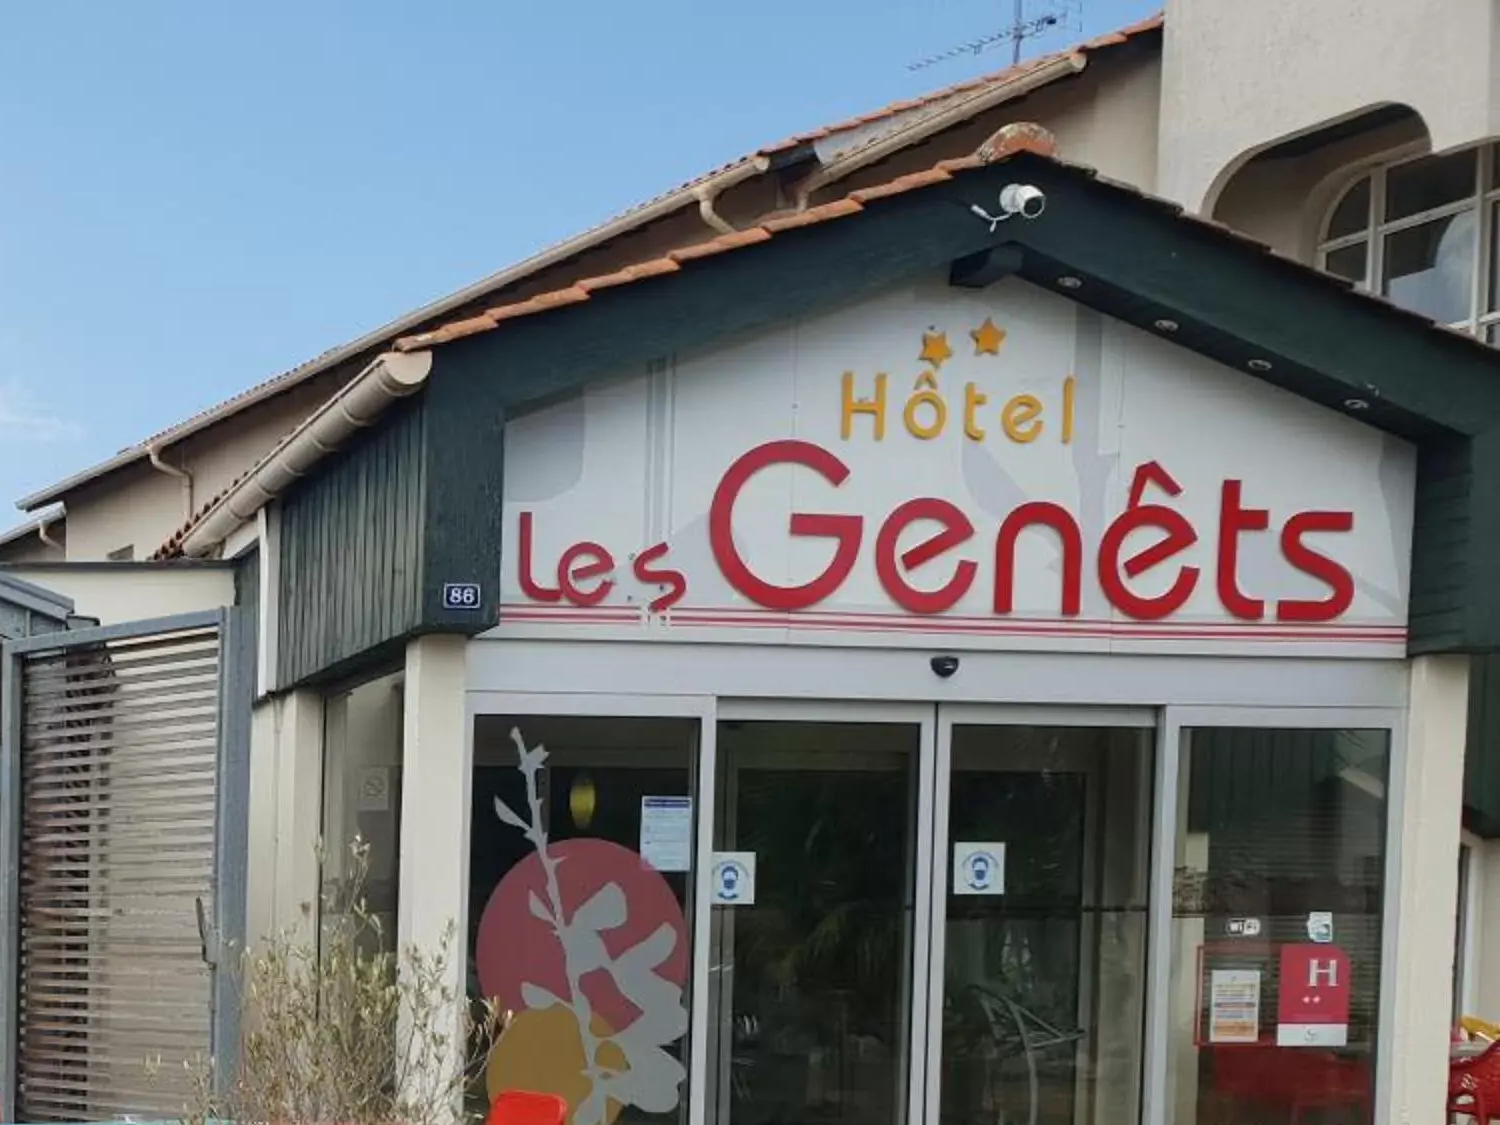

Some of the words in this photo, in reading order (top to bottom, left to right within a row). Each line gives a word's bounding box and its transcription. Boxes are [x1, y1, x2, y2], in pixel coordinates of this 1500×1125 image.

[839, 370, 1077, 445] Hôtel
[518, 511, 687, 612] Les
[709, 439, 1356, 622] Genêts
[449, 587, 476, 605] 86
[1308, 958, 1339, 987] H
